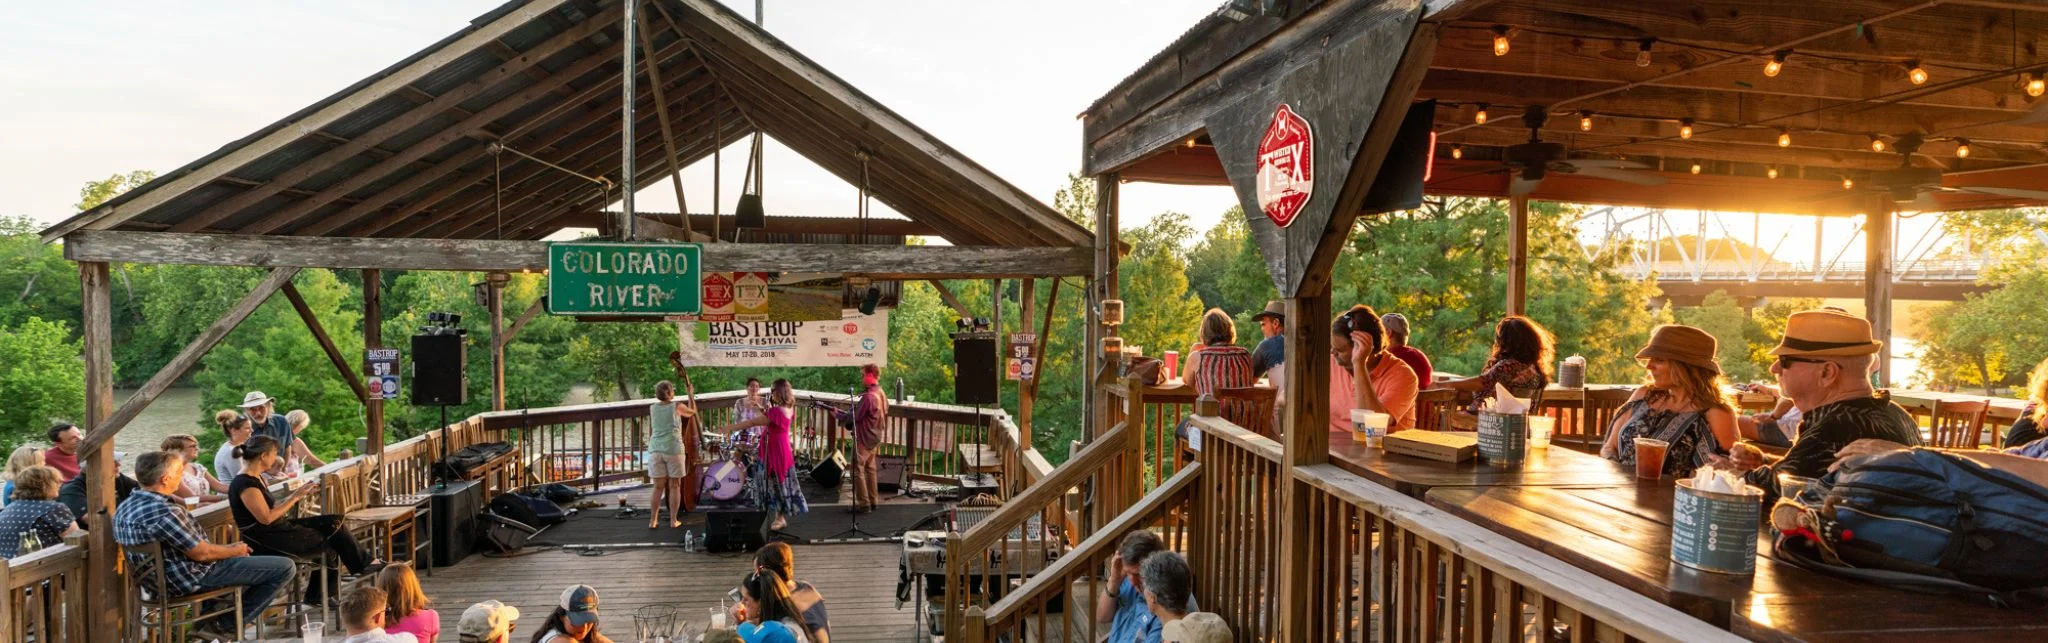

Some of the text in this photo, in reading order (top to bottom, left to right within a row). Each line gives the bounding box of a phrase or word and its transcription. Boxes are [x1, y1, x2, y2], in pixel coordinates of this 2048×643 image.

[563, 251, 688, 275] COLORADO
[590, 284, 662, 307] RIVER
[709, 321, 803, 337] BASTROP
[749, 337, 798, 345] FESTIVAL
[368, 349, 397, 357] BASTROP
